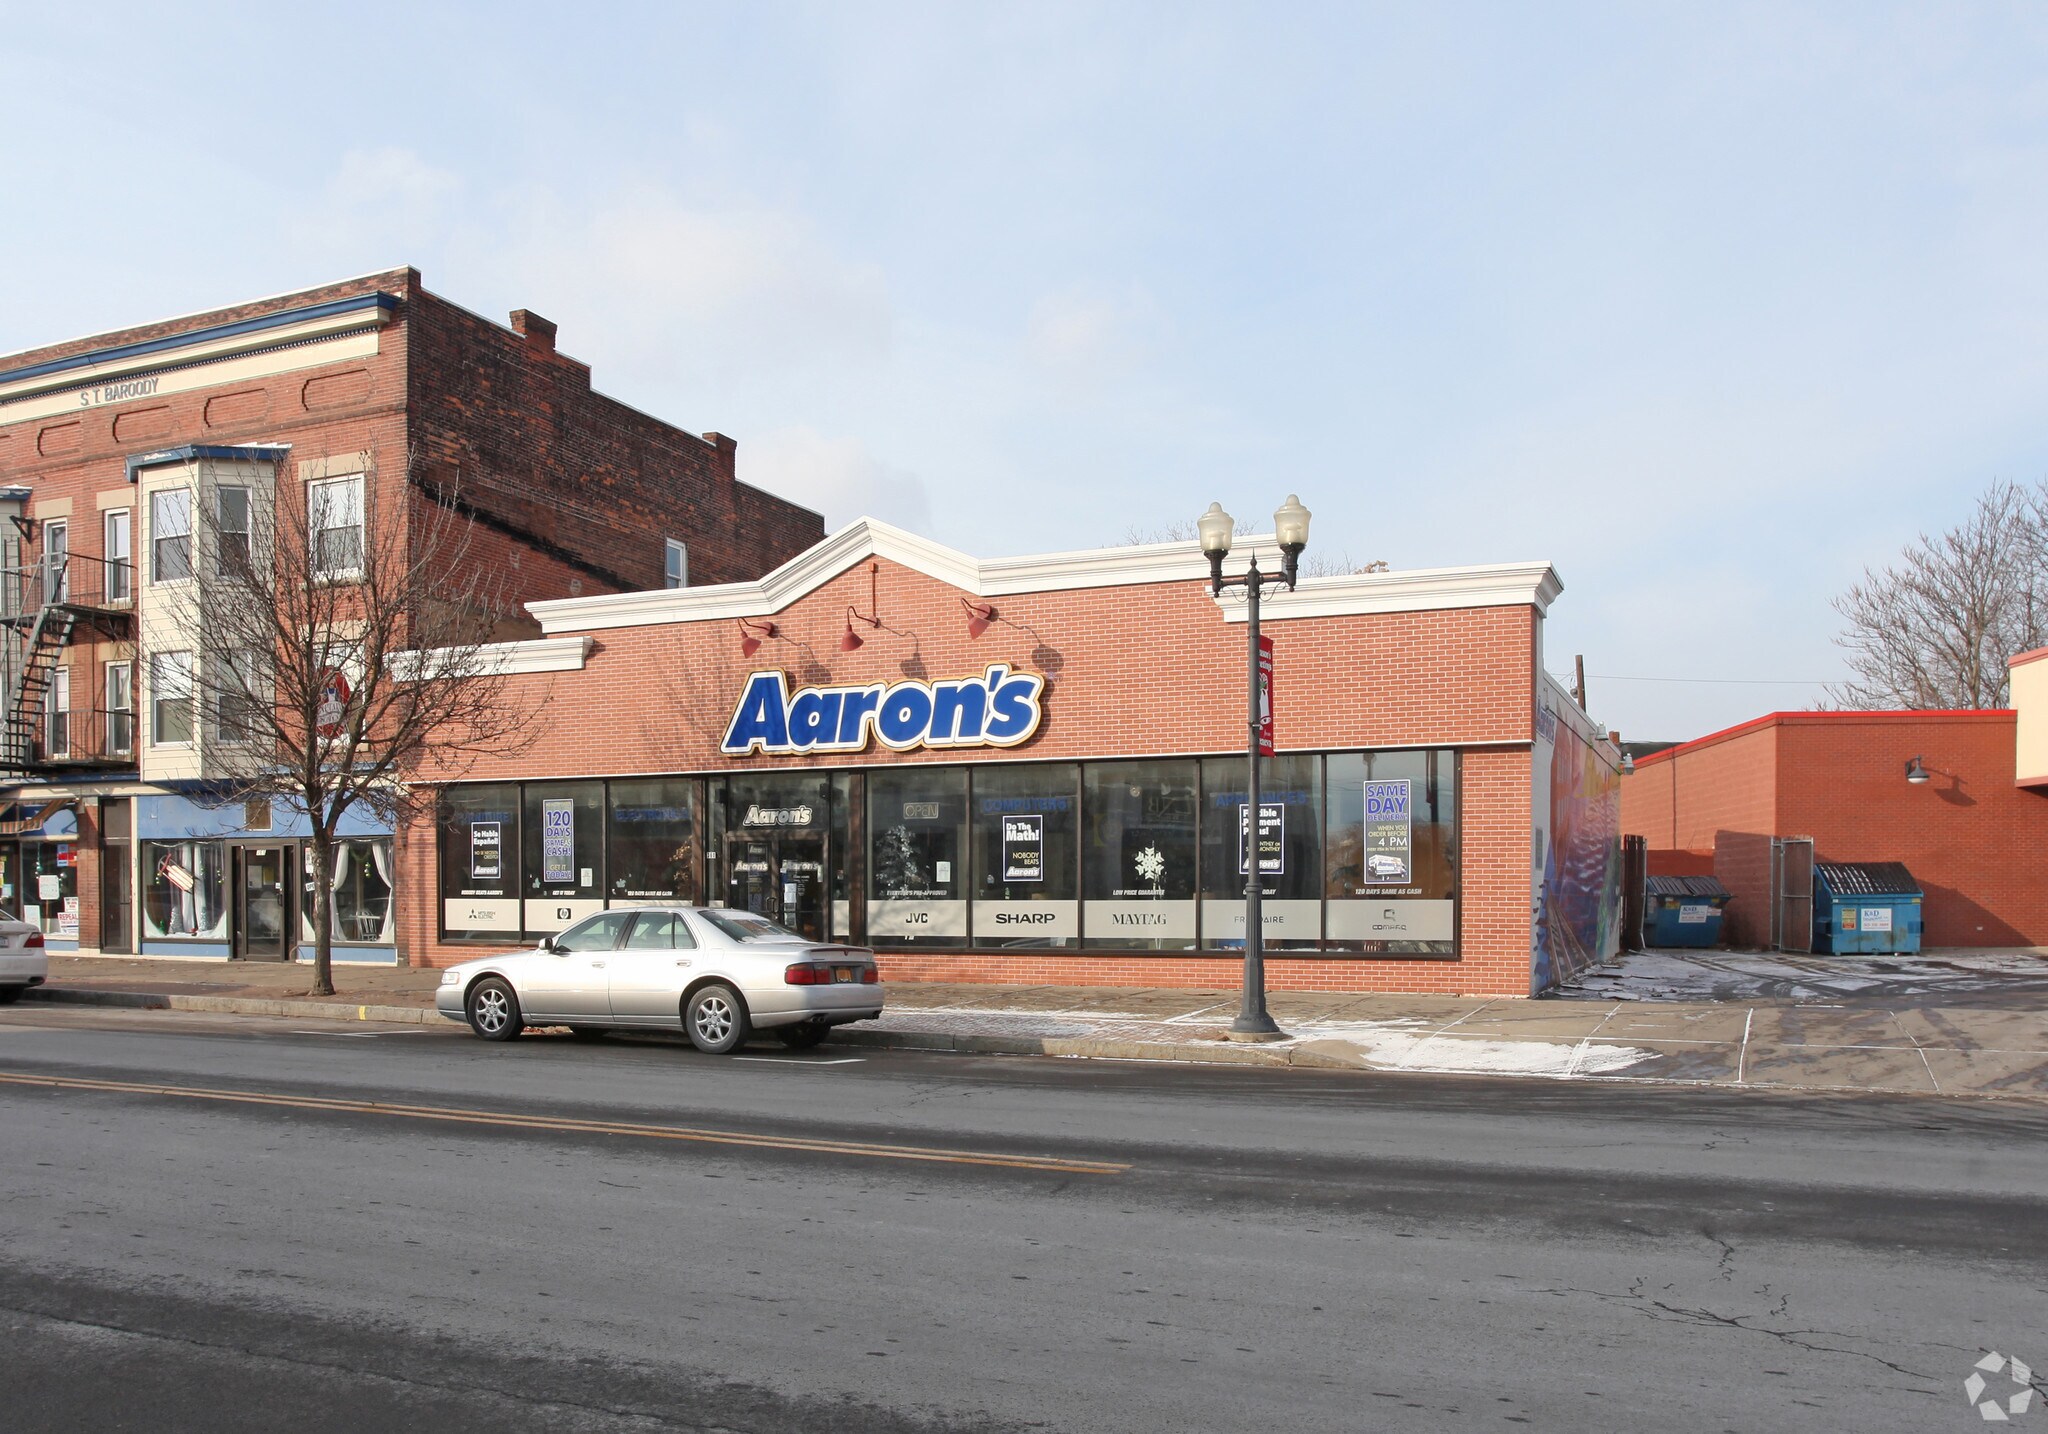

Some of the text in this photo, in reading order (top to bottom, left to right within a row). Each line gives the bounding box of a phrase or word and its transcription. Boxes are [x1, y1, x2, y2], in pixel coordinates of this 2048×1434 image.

[104, 378, 159, 401] BAROODY
[719, 662, 1046, 755] Aaron's
[1368, 784, 1406, 797] SAME
[1215, 790, 1308, 806] APPANCES
[905, 805, 938, 817] OPEN
[1367, 797, 1407, 814] DAY
[546, 811, 571, 827] 120
[744, 804, 812, 826] Aaron's
[1017, 822, 1031, 830] The
[482, 830, 498, 838] Habla
[546, 828, 571, 837] DAYS
[1006, 830, 1040, 841] Math!
[1378, 837, 1408, 846] 4 PM
[546, 847, 571, 856] CASH!
[734, 860, 768, 871] Aaron's
[1006, 866, 1040, 877] Aaron's
[906, 913, 928, 923] JVC
[996, 914, 1055, 924] SHARP
[1112, 914, 1167, 925] MAYTAG
